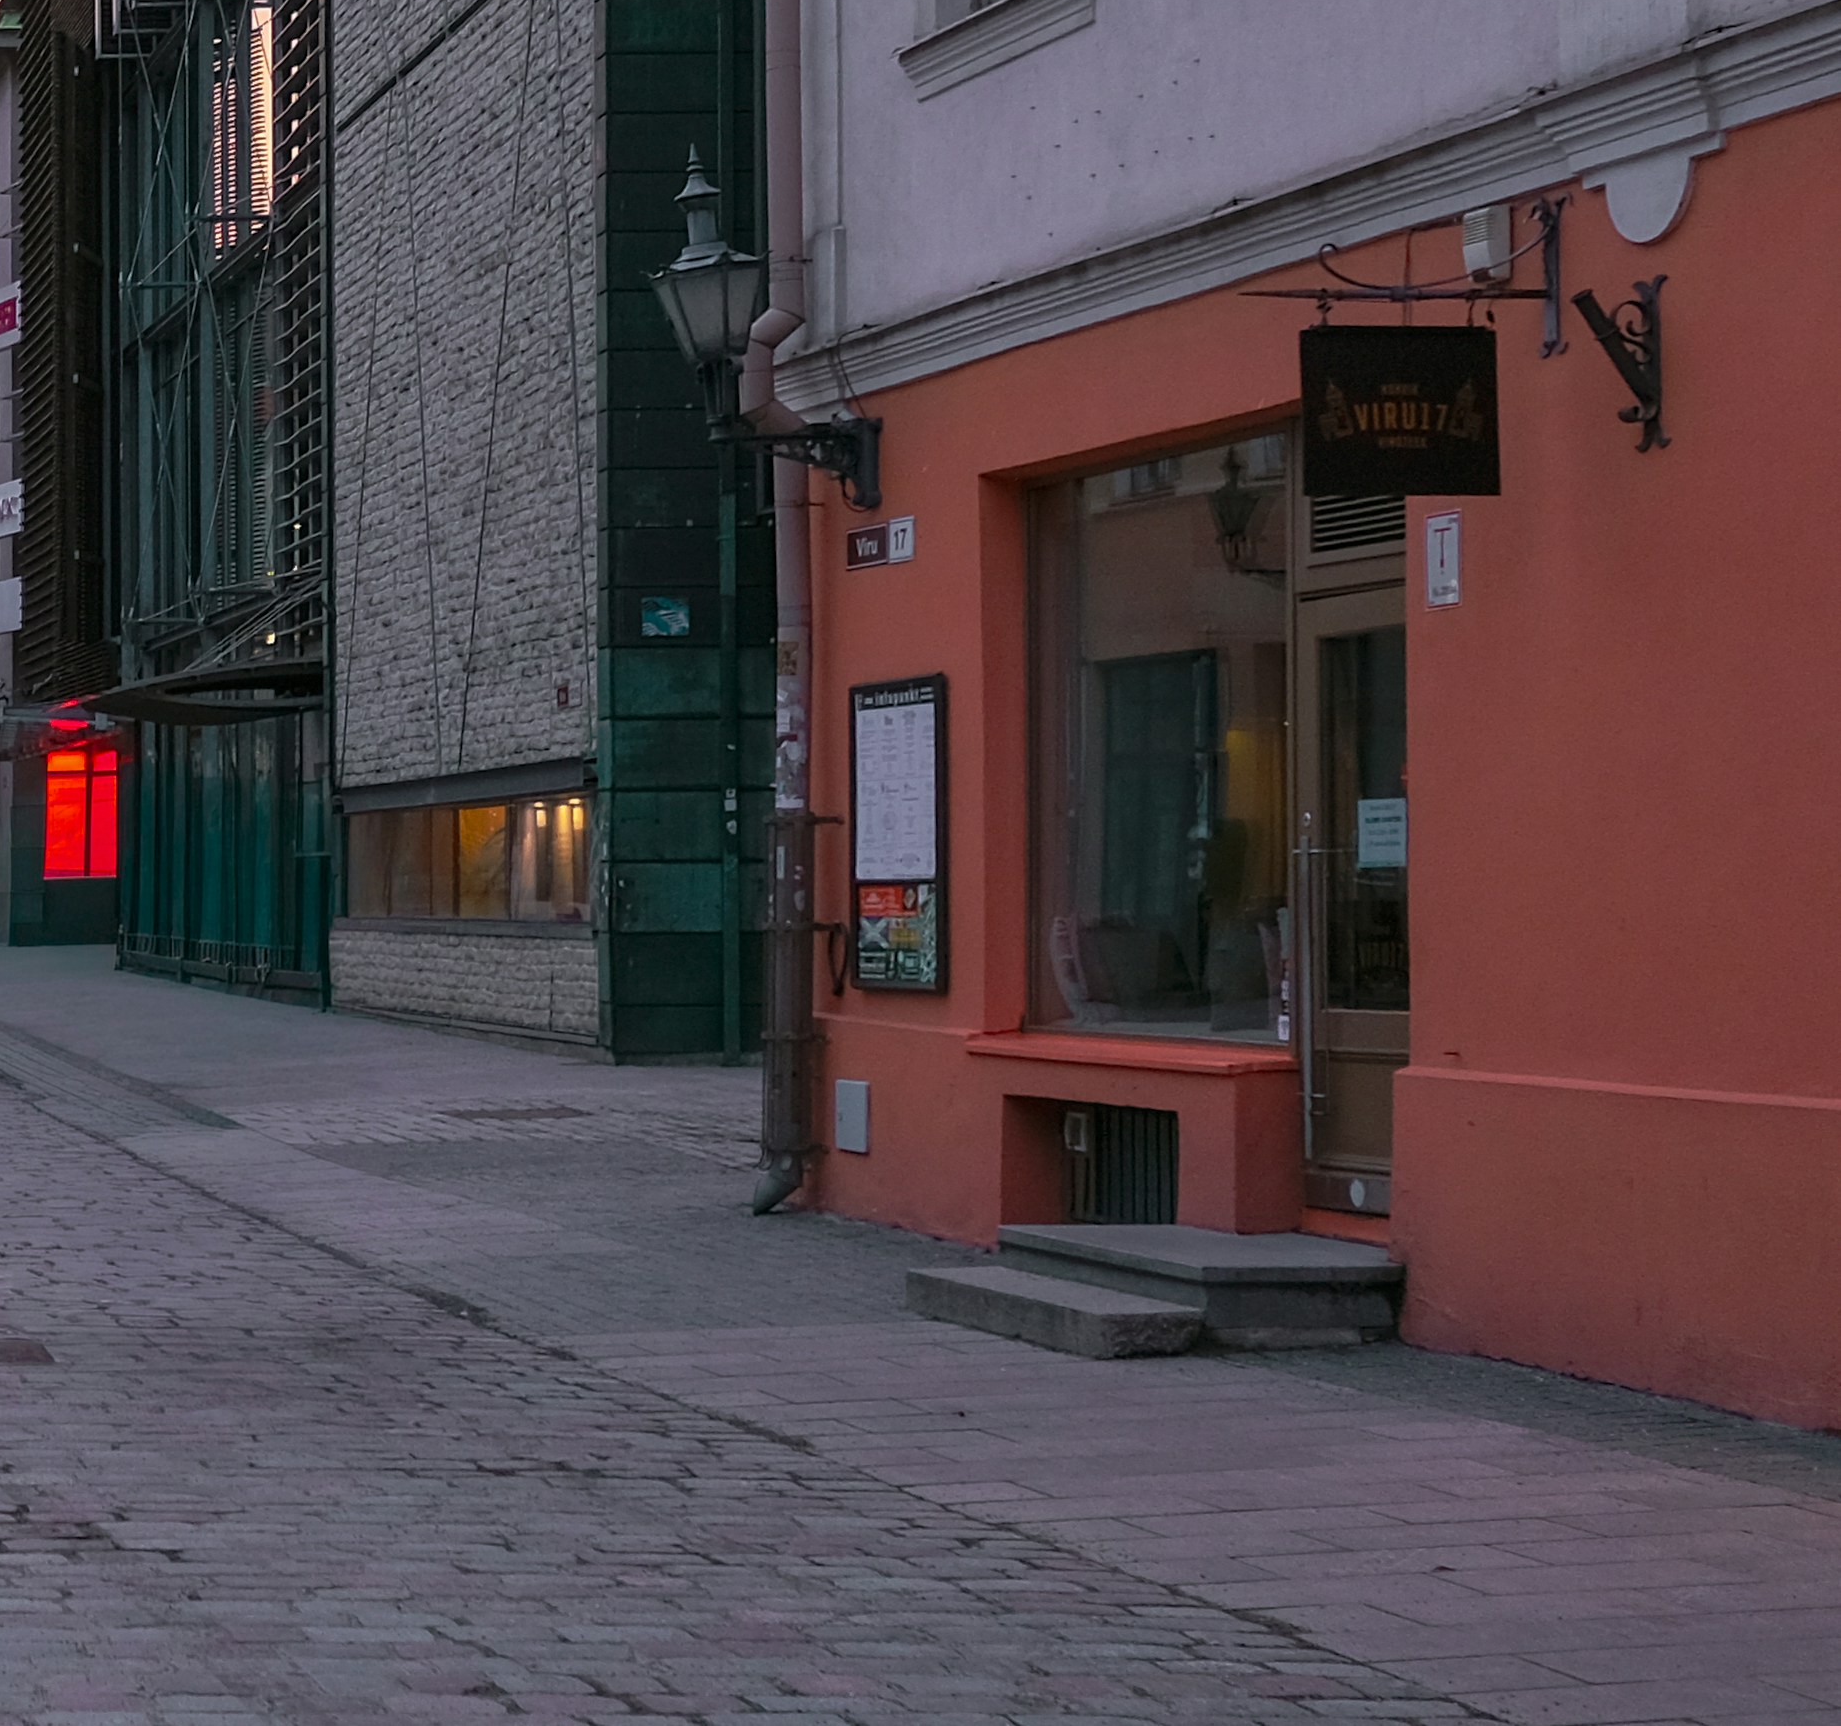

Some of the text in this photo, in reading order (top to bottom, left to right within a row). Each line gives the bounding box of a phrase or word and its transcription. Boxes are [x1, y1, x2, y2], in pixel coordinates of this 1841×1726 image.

[1353, 402, 1448, 431] VIRU17
[856, 528, 907, 557] Viru 17
